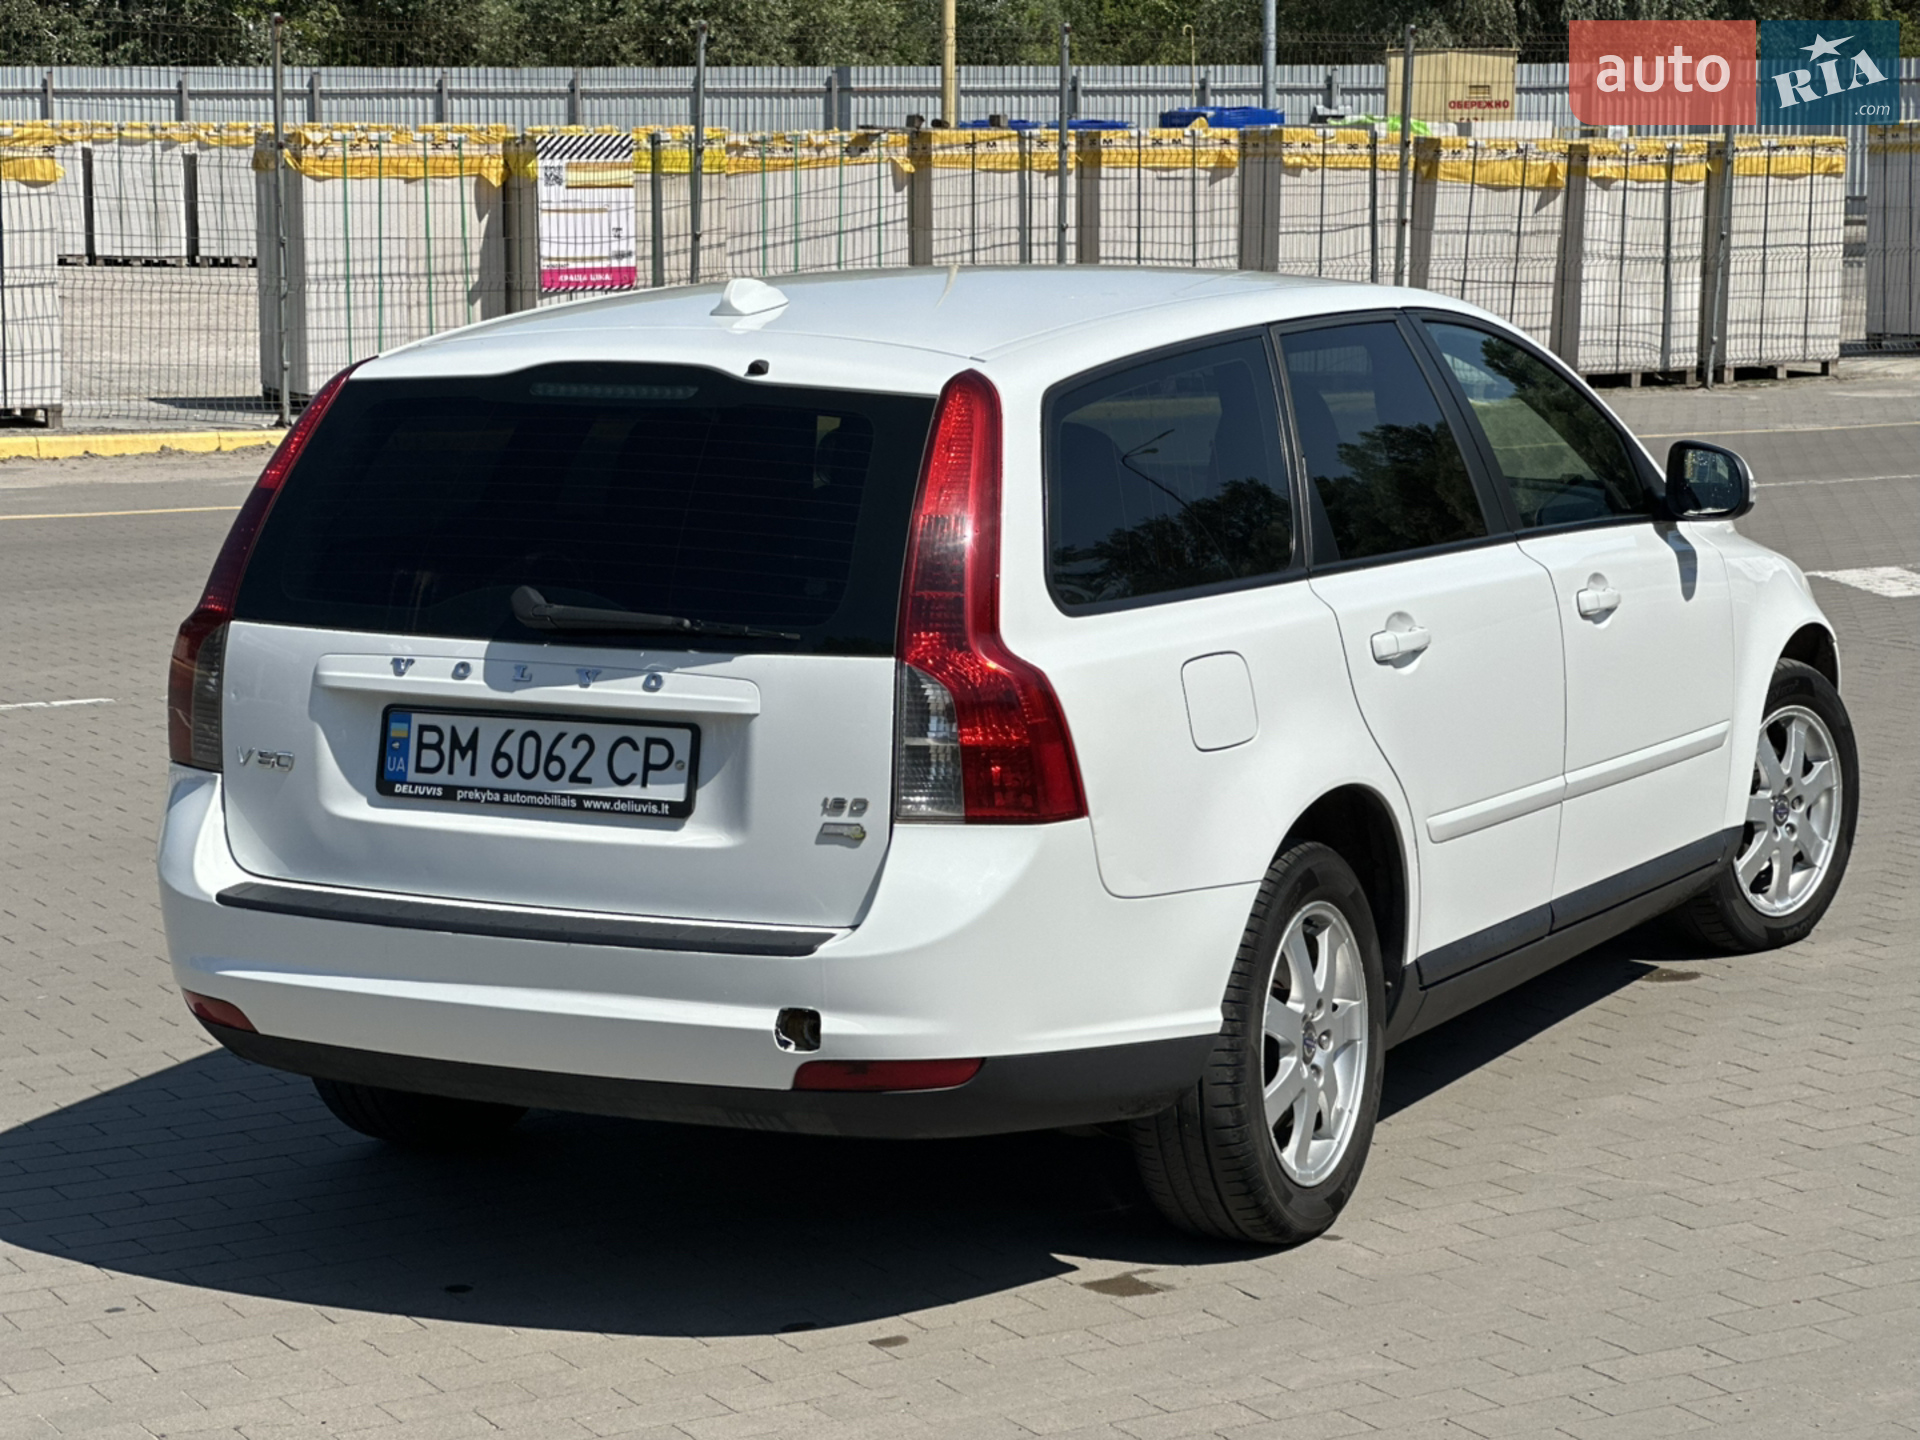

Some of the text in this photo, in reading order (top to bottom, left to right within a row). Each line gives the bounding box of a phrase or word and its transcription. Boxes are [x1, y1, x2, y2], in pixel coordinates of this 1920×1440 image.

[1448, 100, 1509, 109] ОБЕРЕЖНО
[391, 657, 664, 692] VOLVO
[236, 746, 295, 772] V50
[387, 756, 406, 773] UA
[414, 724, 675, 788] BM 6062 CP
[394, 784, 443, 797] DELIUVIS
[457, 788, 669, 815] prekyba automobiliais www.deliuvis.lt
